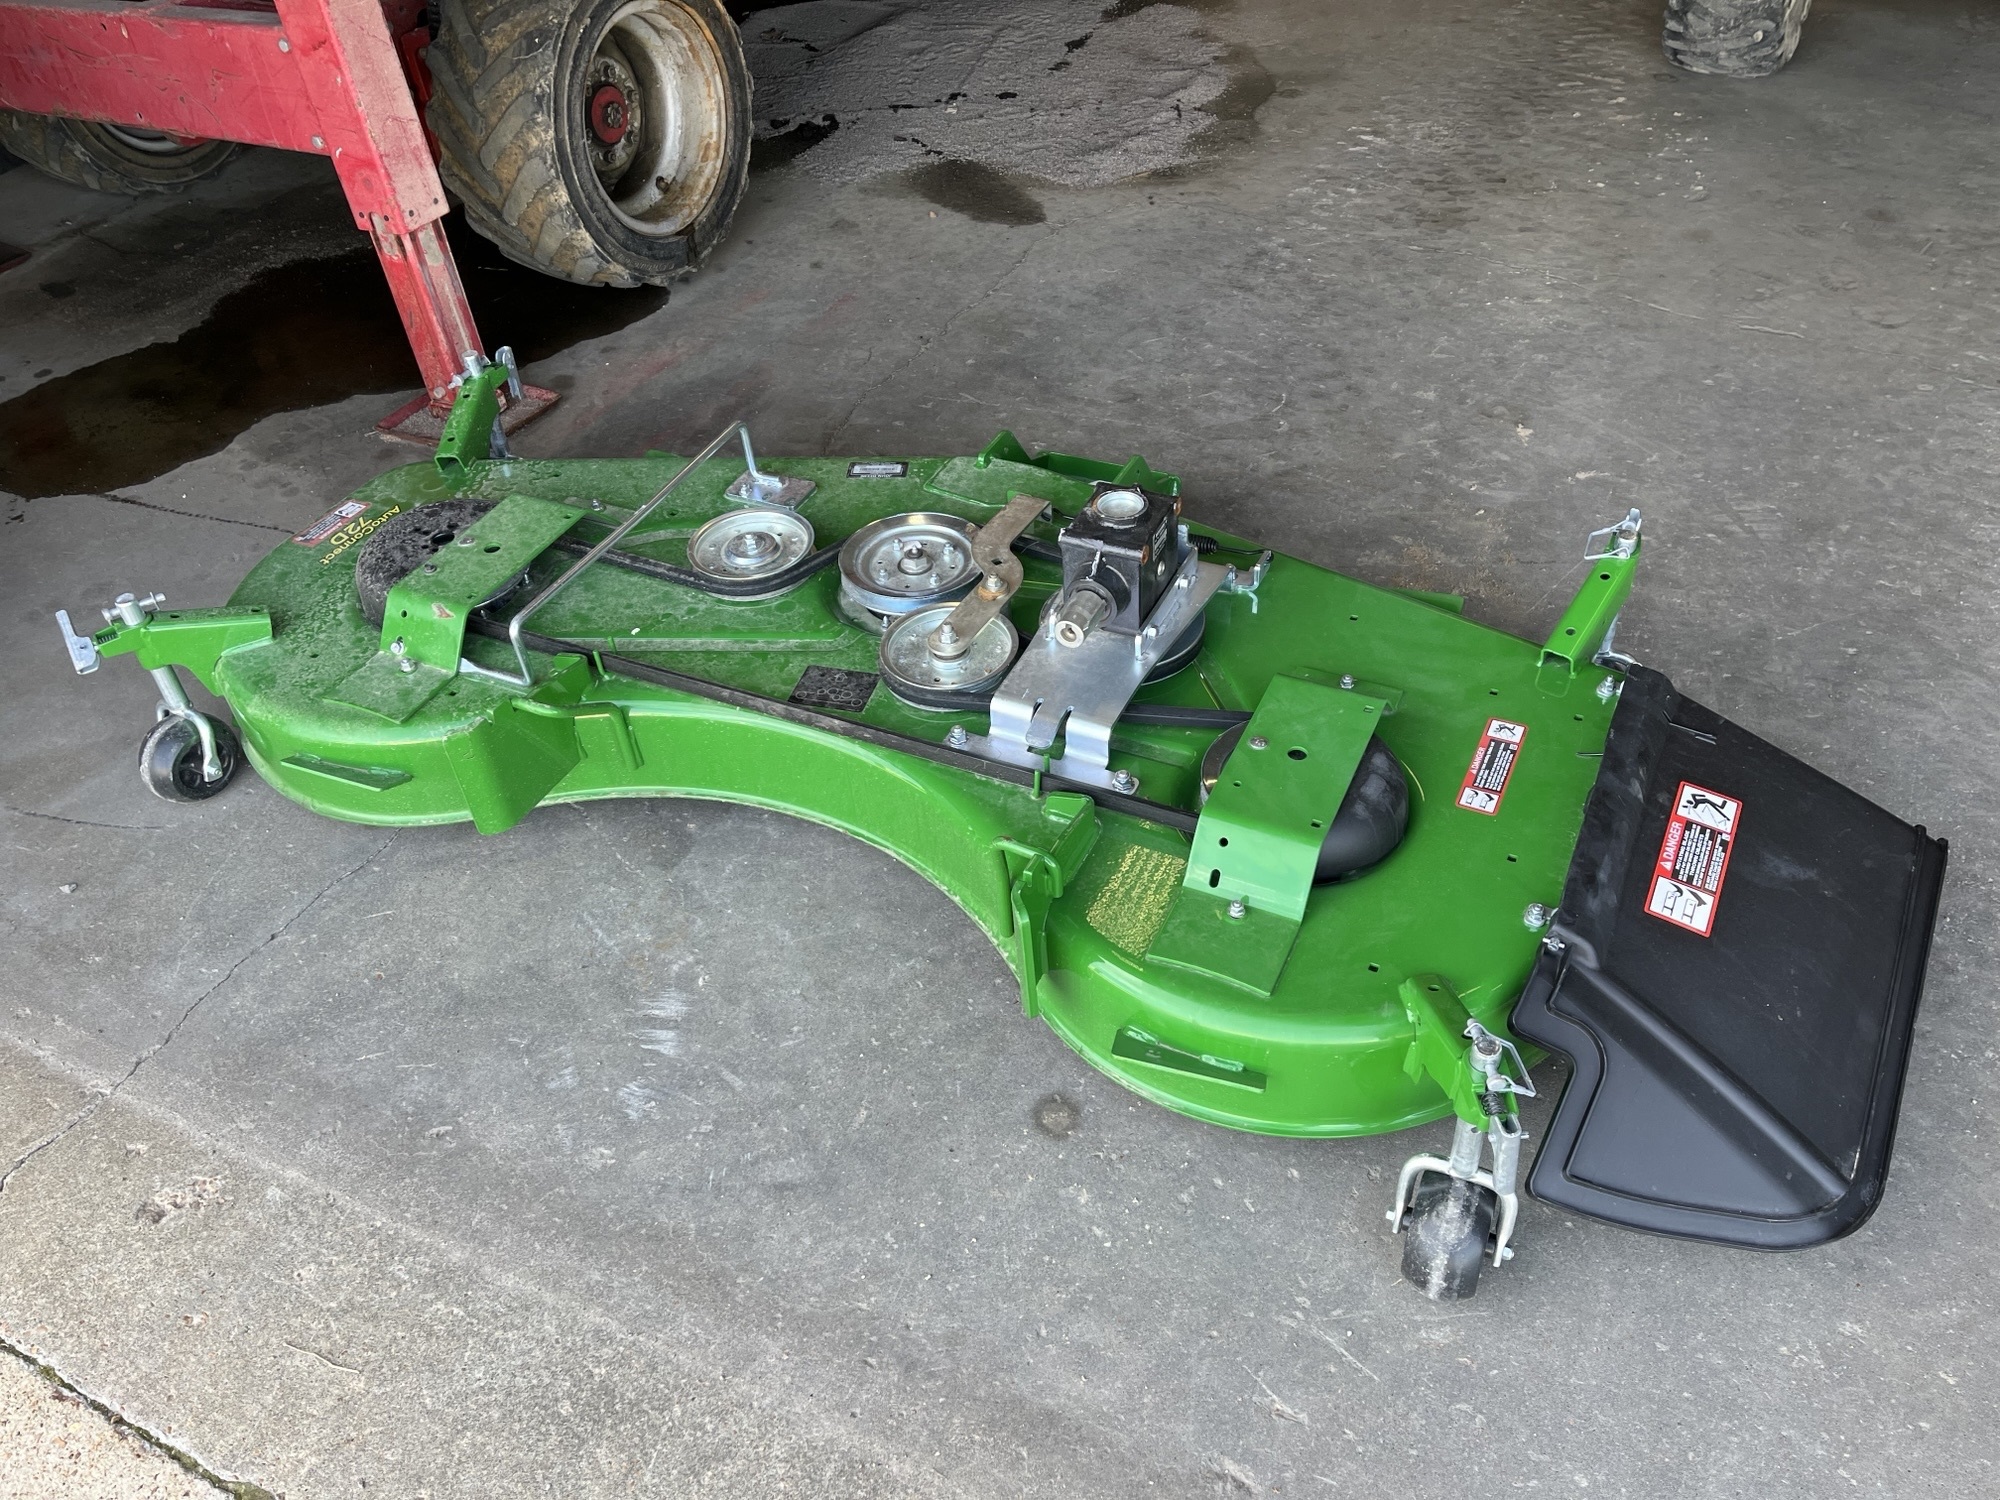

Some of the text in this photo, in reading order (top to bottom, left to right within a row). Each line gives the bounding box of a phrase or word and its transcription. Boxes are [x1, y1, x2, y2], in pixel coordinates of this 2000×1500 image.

[319, 505, 402, 565] AutoConnect
[330, 516, 372, 545] 72D
[1472, 747, 1486, 769] DANGER
[1662, 821, 1682, 860] DANGER
[1675, 845, 1685, 869] ROTATING
